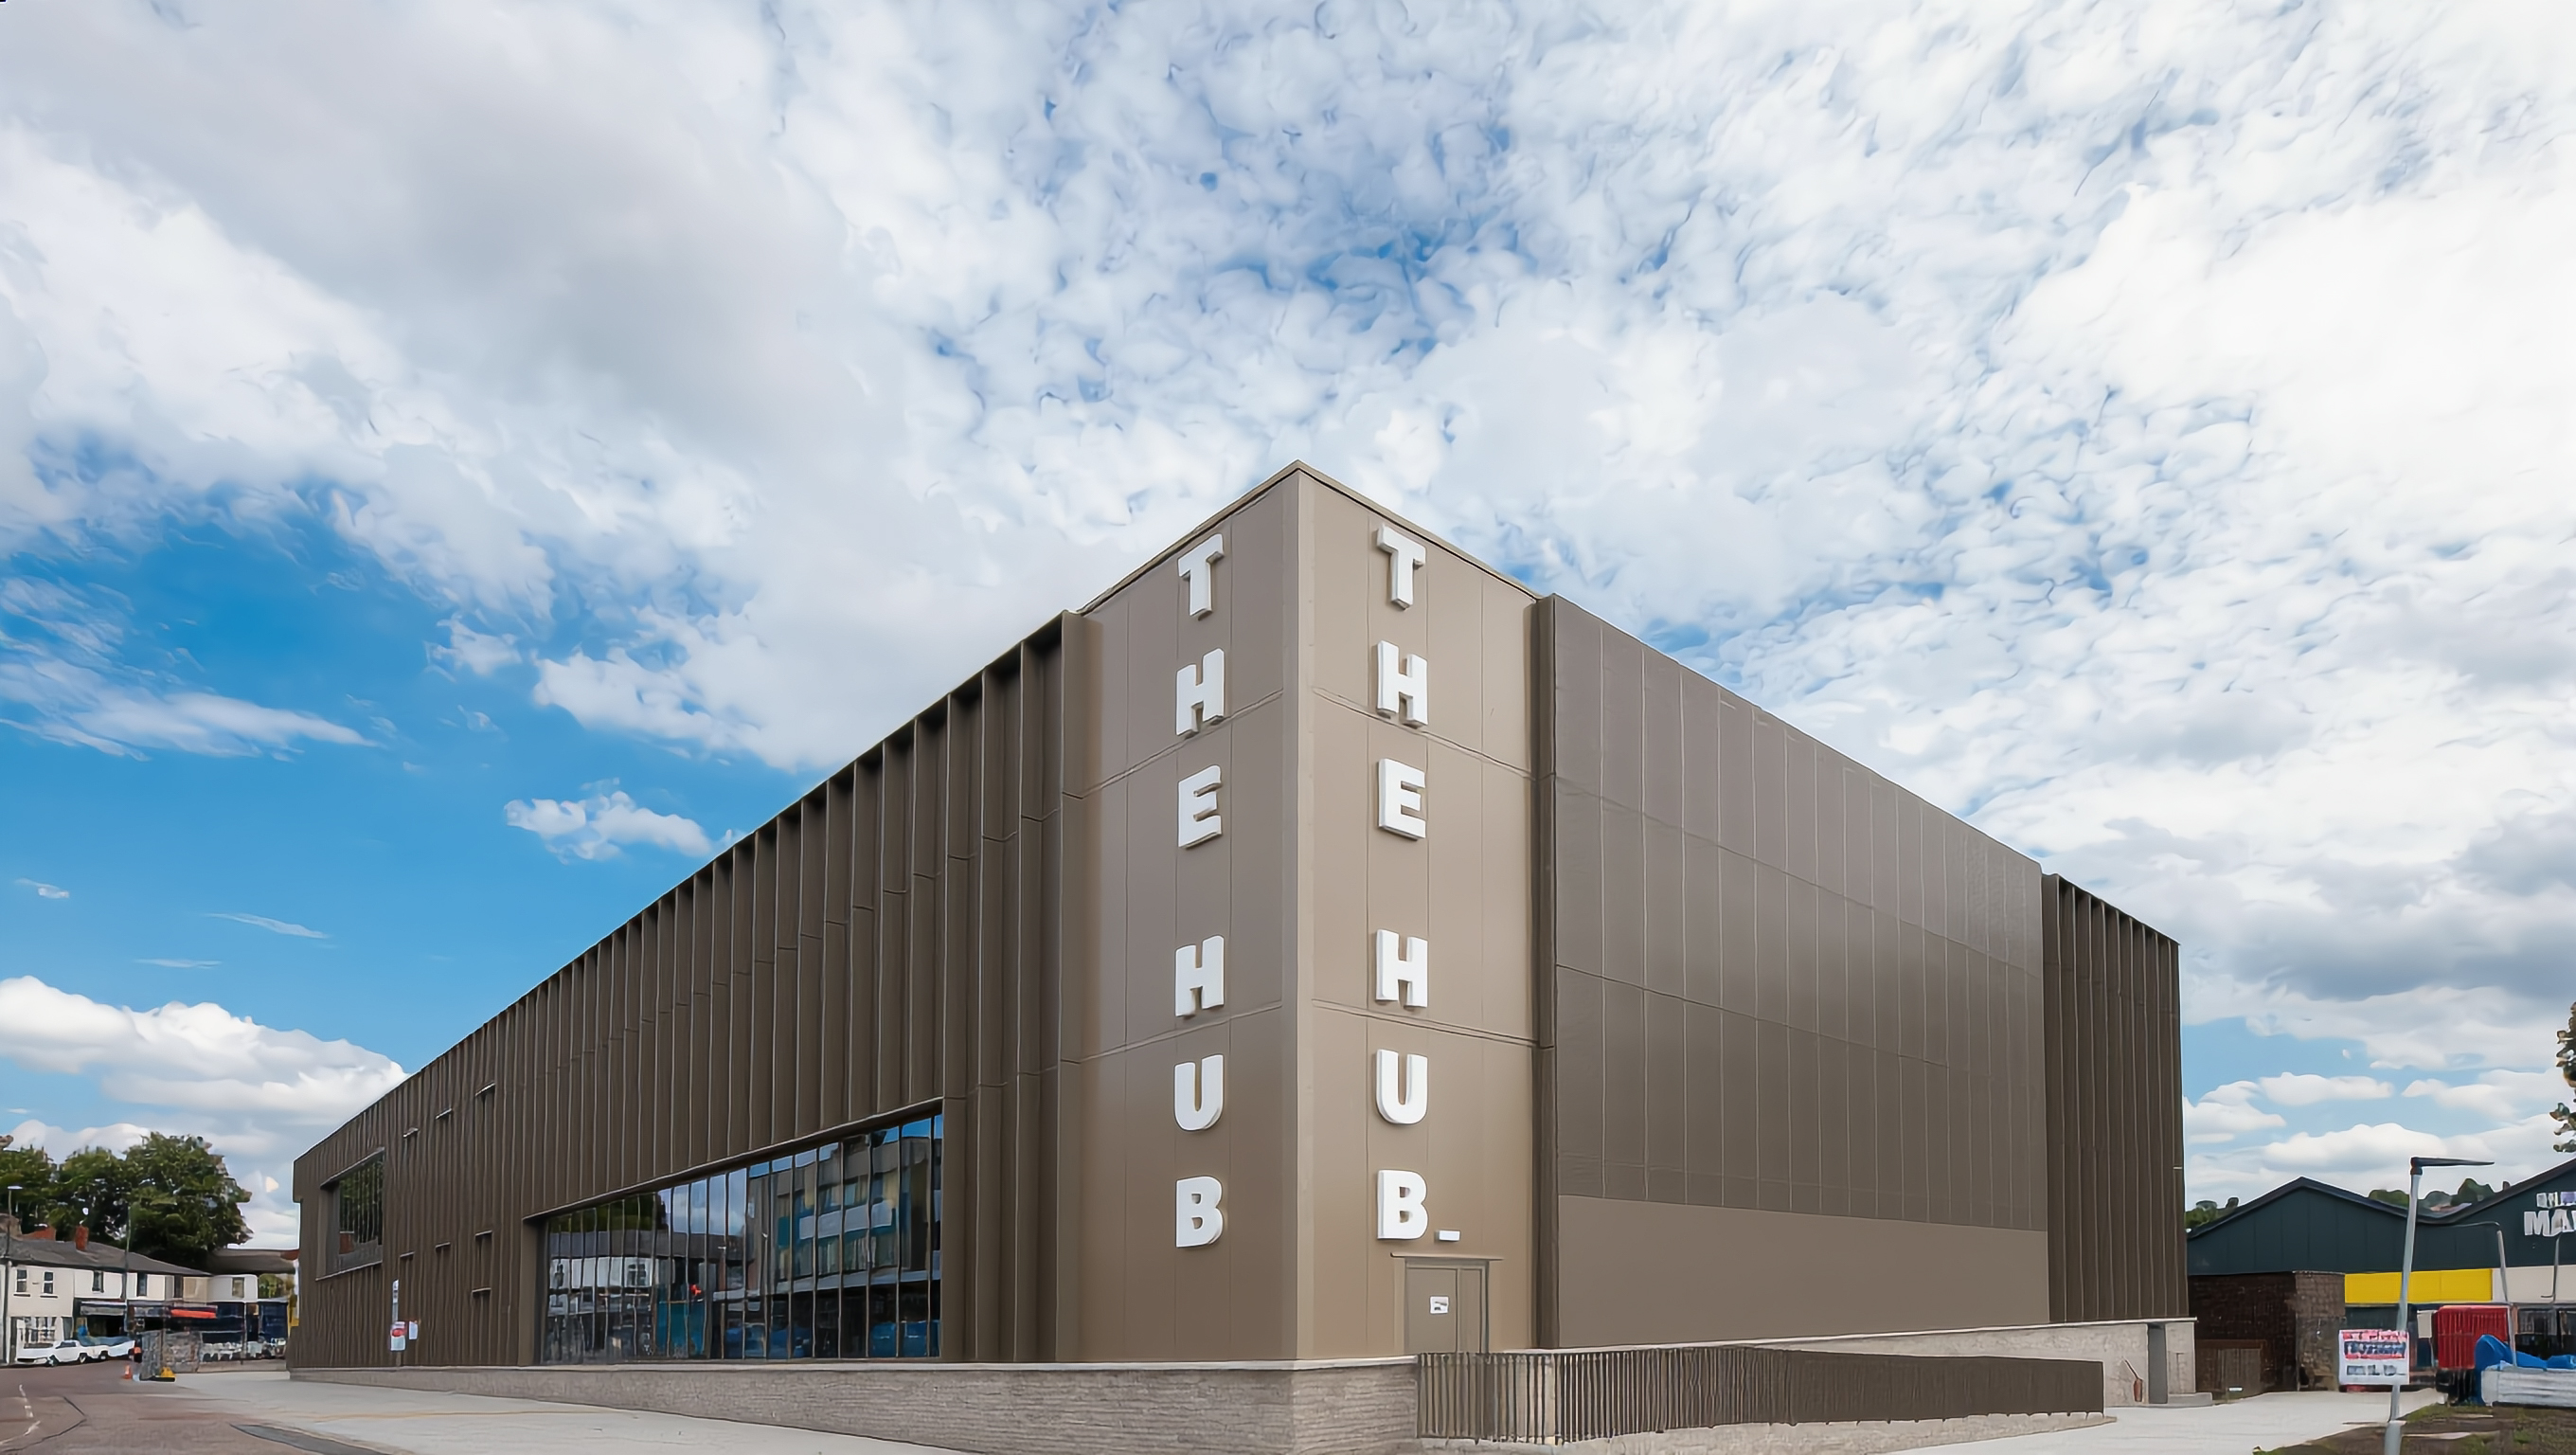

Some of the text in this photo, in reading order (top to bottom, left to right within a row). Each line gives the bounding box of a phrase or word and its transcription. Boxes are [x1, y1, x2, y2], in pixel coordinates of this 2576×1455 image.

[1174, 533, 1225, 1248] THE HUB
[1376, 523, 1428, 1240] THE HUB
